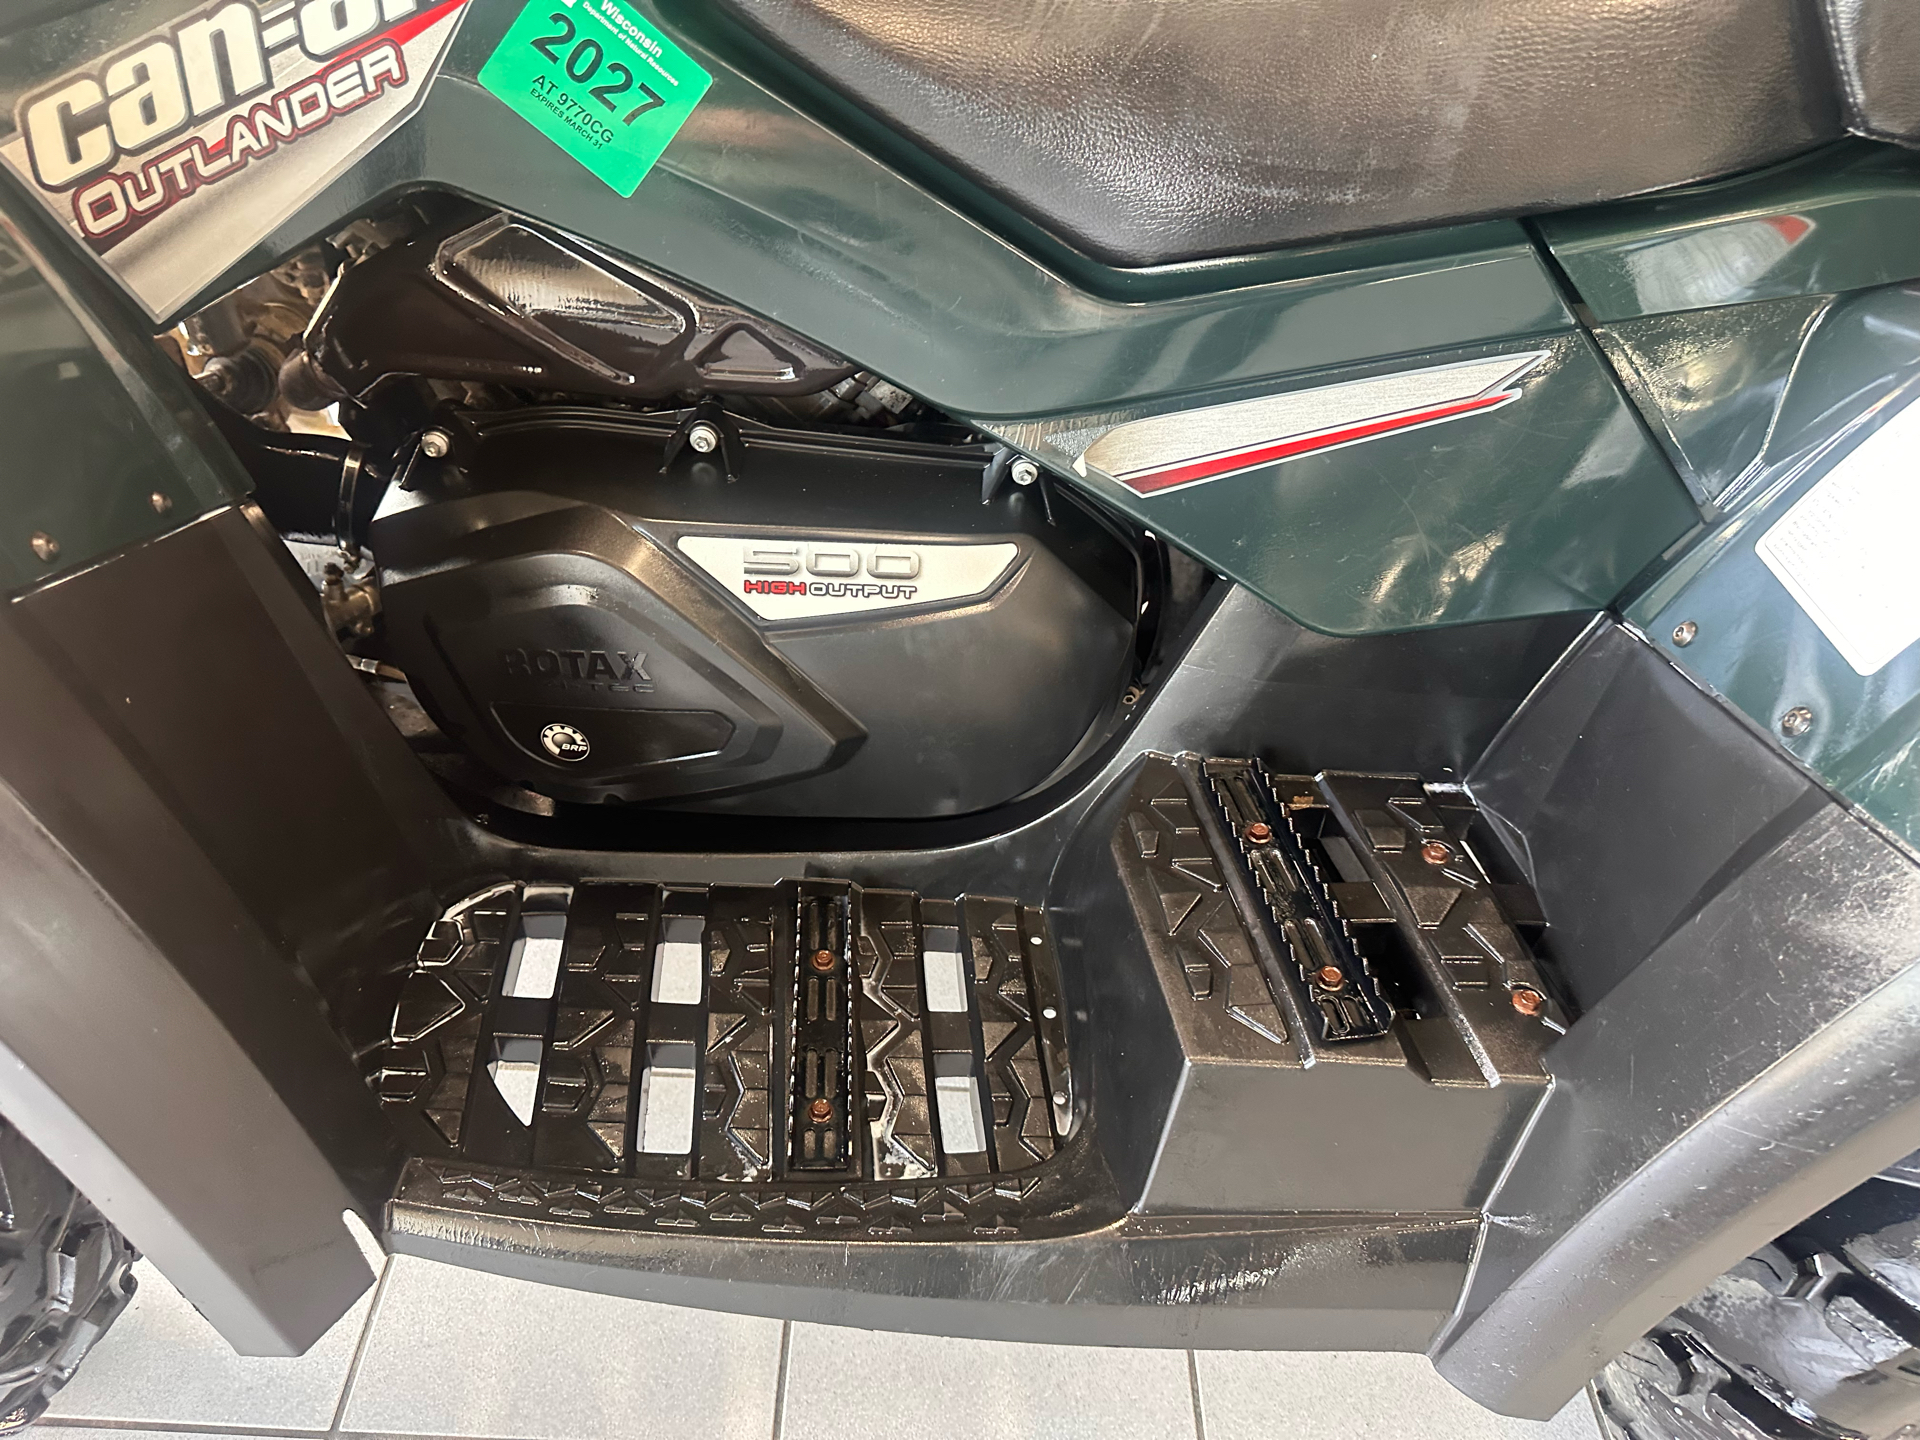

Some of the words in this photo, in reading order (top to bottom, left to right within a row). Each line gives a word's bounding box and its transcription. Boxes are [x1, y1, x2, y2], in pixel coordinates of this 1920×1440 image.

[582, 1, 619, 35] Department
[617, 31, 627, 41] of
[624, 37, 649, 60] Natural
[646, 56, 679, 86] Resources
[600, 0, 663, 58] Wisconsin
[530, 12, 666, 126] 2027
[75, 41, 405, 236] OUTLANDER
[530, 88, 565, 118] EXPIRES
[563, 115, 594, 142] MARCH
[592, 139, 603, 150] 31
[532, 75, 558, 95] AT
[557, 93, 614, 143] 9770CG
[743, 547, 921, 580] 500
[743, 580, 806, 596] HIGH
[808, 582, 918, 599] OUTPUT
[504, 648, 652, 682] ROTAX
[561, 743, 588, 752] BRP
